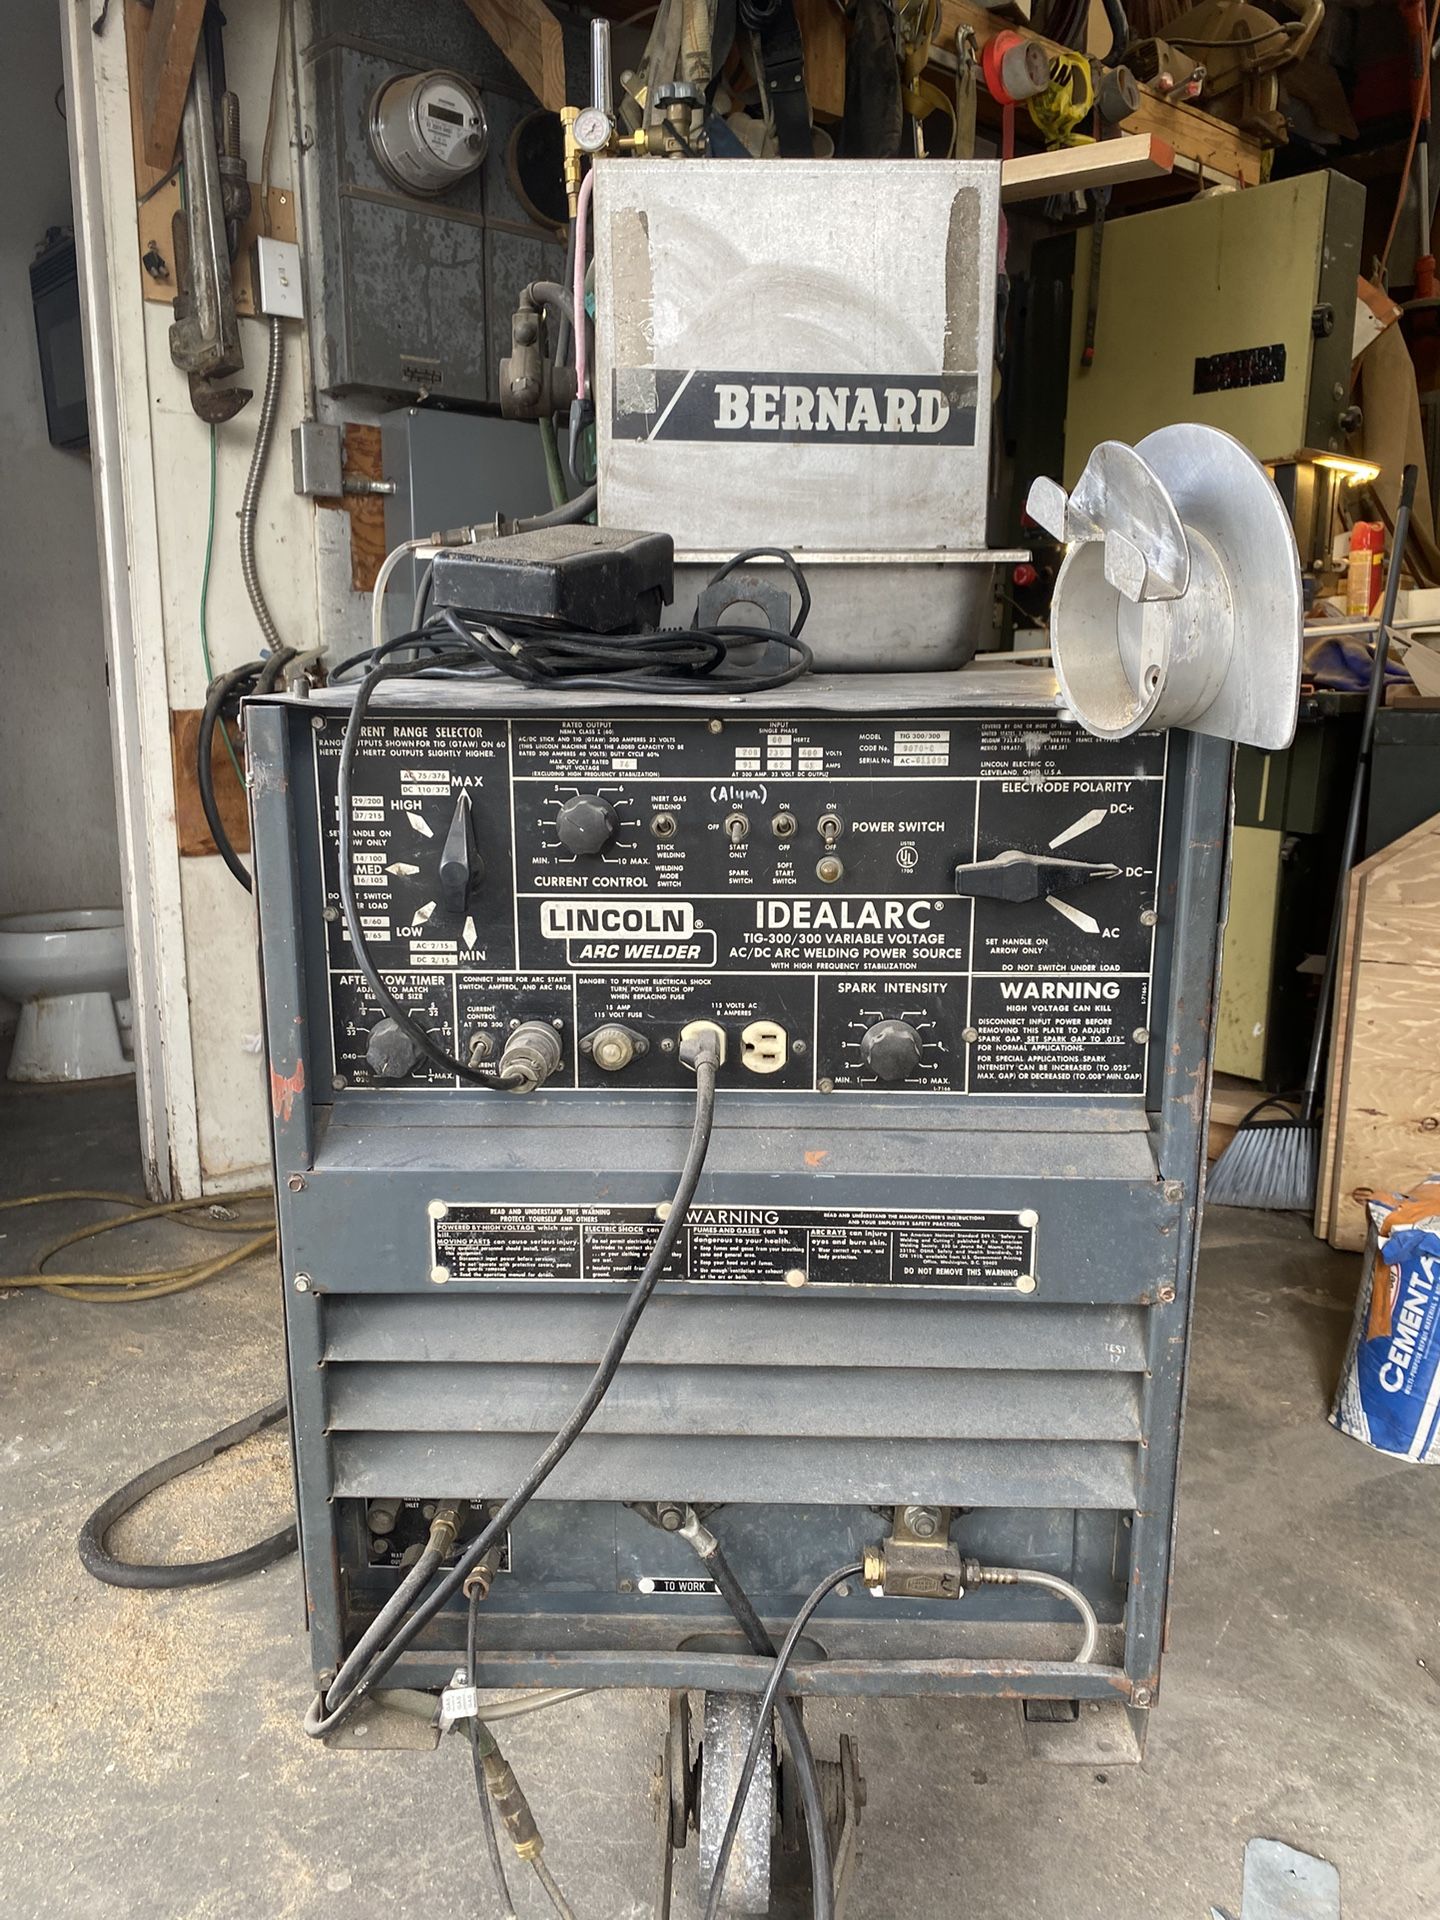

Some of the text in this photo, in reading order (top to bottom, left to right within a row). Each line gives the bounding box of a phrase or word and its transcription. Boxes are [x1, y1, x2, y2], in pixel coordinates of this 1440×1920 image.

[714, 385, 949, 432] BERNARD
[394, 727, 428, 737] RANGE
[436, 728, 482, 738] SELECTOR
[452, 776, 483, 786] MAX
[1002, 782, 1131, 792] ELECTRODE POLARITY
[391, 800, 422, 810] HIGH
[1110, 804, 1134, 813] DC+
[853, 822, 944, 832] POWER SWITCH
[356, 865, 382, 874] MED
[534, 877, 648, 887] CURRENT CONTROL
[757, 901, 930, 928] IDEALARC
[550, 909, 684, 931] LINCOLN
[396, 927, 422, 936] LOW
[1102, 928, 1120, 938] AC
[744, 933, 944, 945] TIG-300/300 VARIABLE VOLTAGE
[460, 951, 485, 960] MIN
[580, 945, 700, 958] ARC WELDER
[730, 948, 961, 959] AC/DC ARC WELDING POWER SOURCE
[410, 976, 444, 985] TIMER
[838, 983, 947, 992] SPARK INTENSITY
[1000, 982, 1120, 998] WARNING
[686, 1210, 779, 1224] WARNING
[664, 1582, 705, 1591] TO WORK
